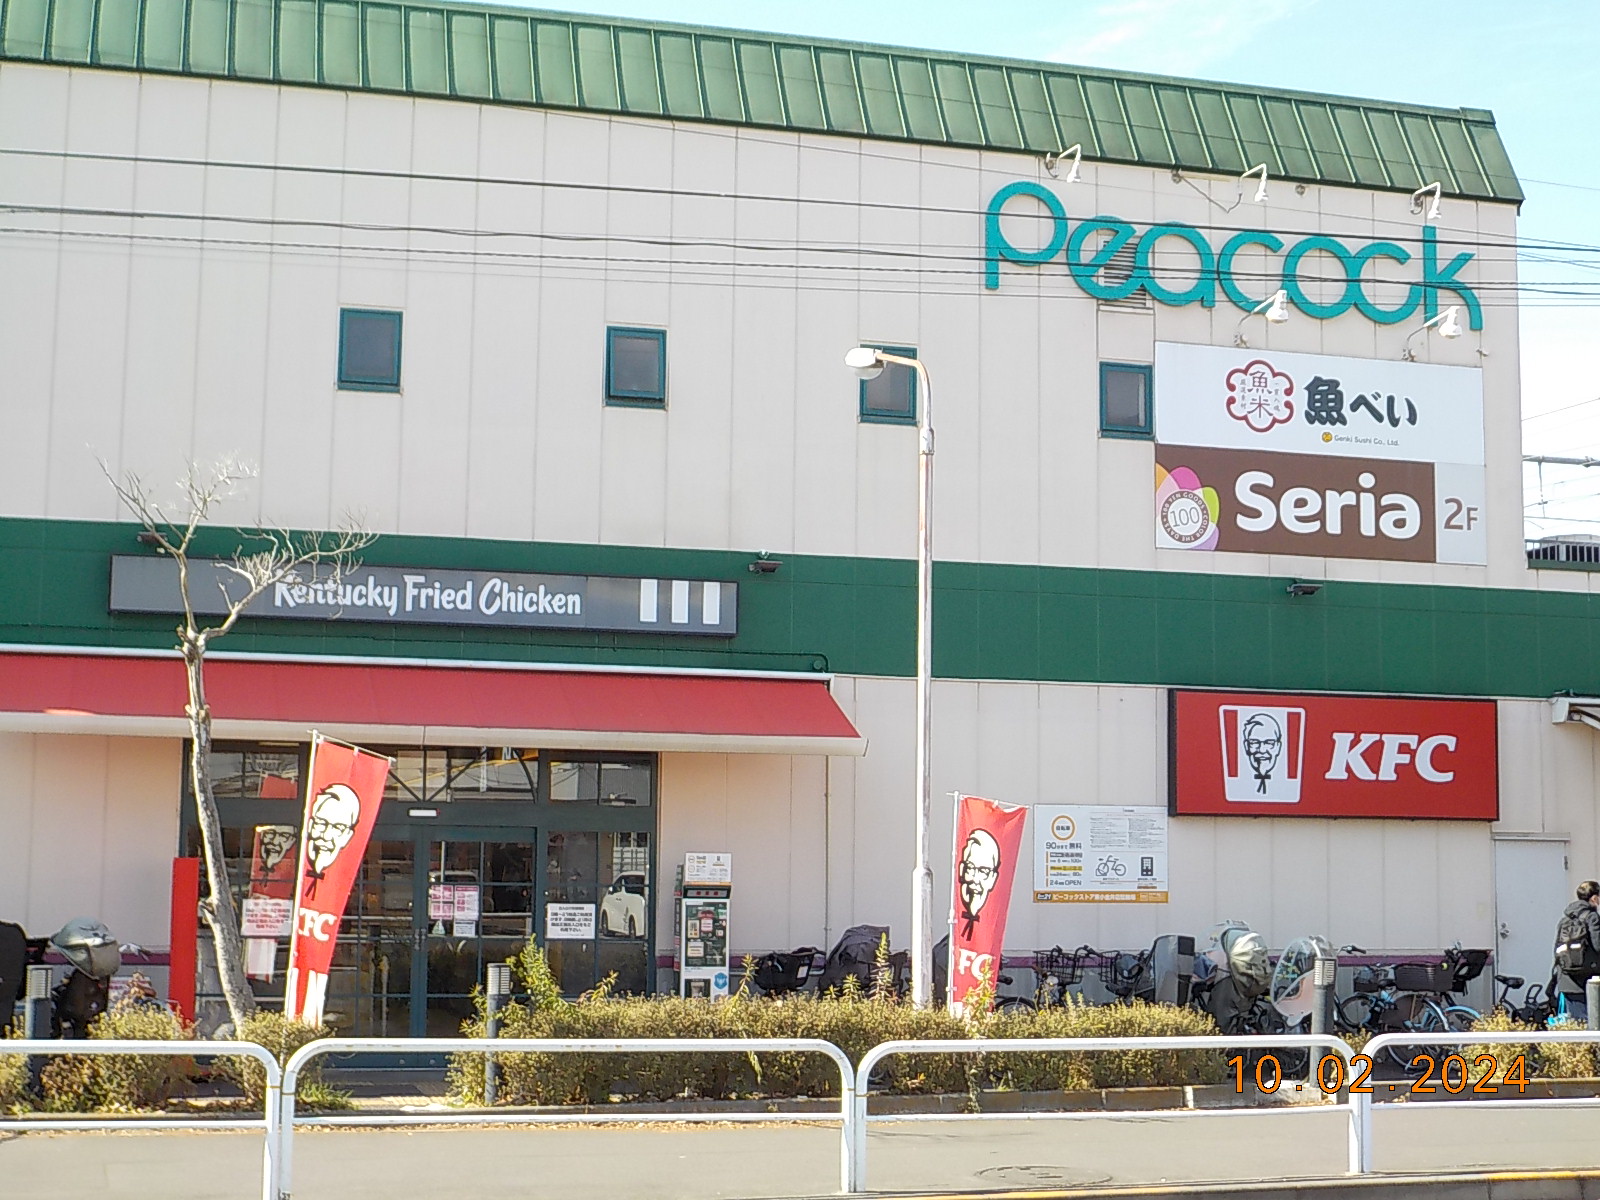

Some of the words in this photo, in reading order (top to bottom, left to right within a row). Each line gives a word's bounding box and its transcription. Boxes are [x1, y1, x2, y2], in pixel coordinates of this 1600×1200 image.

[1303, 375, 1418, 428] 魚べい
[1334, 434, 1353, 443] Genki
[1354, 436, 1372, 444] Sushi
[1170, 506, 1200, 527] 100
[1235, 470, 1420, 540] Seria
[1443, 497, 1479, 531] 2F
[274, 573, 398, 617] Kentucky
[402, 574, 473, 612] Fried
[478, 577, 581, 615] Chicken
[1324, 732, 1457, 783] KFC
